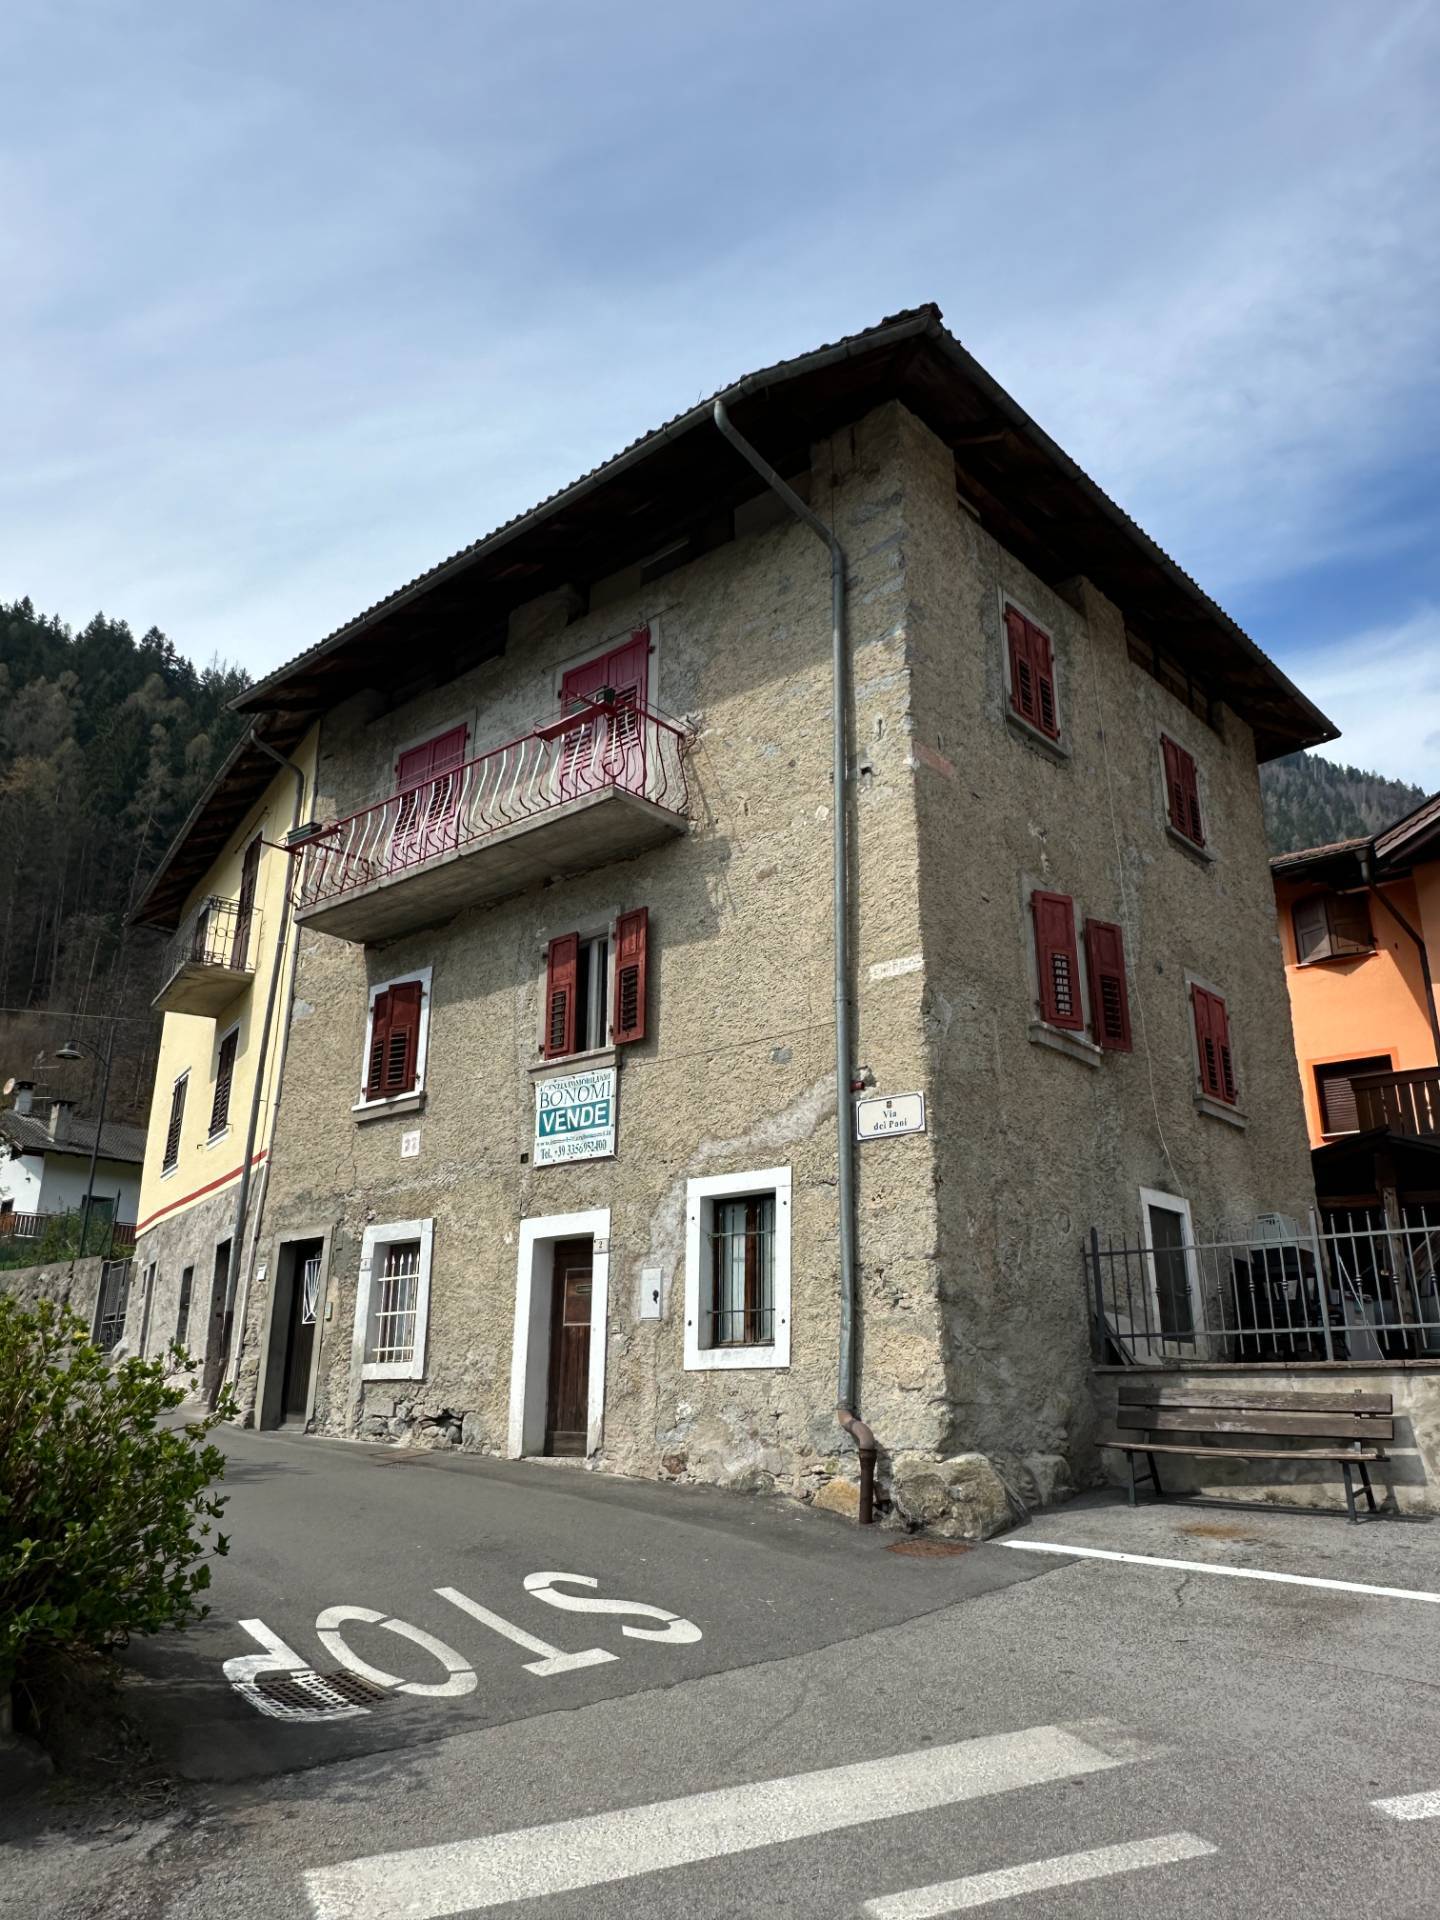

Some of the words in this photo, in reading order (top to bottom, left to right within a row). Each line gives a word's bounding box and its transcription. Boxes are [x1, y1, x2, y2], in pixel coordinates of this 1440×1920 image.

[540, 1081, 611, 1109] BONOMI
[543, 1102, 607, 1133] VENDE
[883, 1110, 897, 1118] Via
[222, 1571, 703, 1722] STOP
